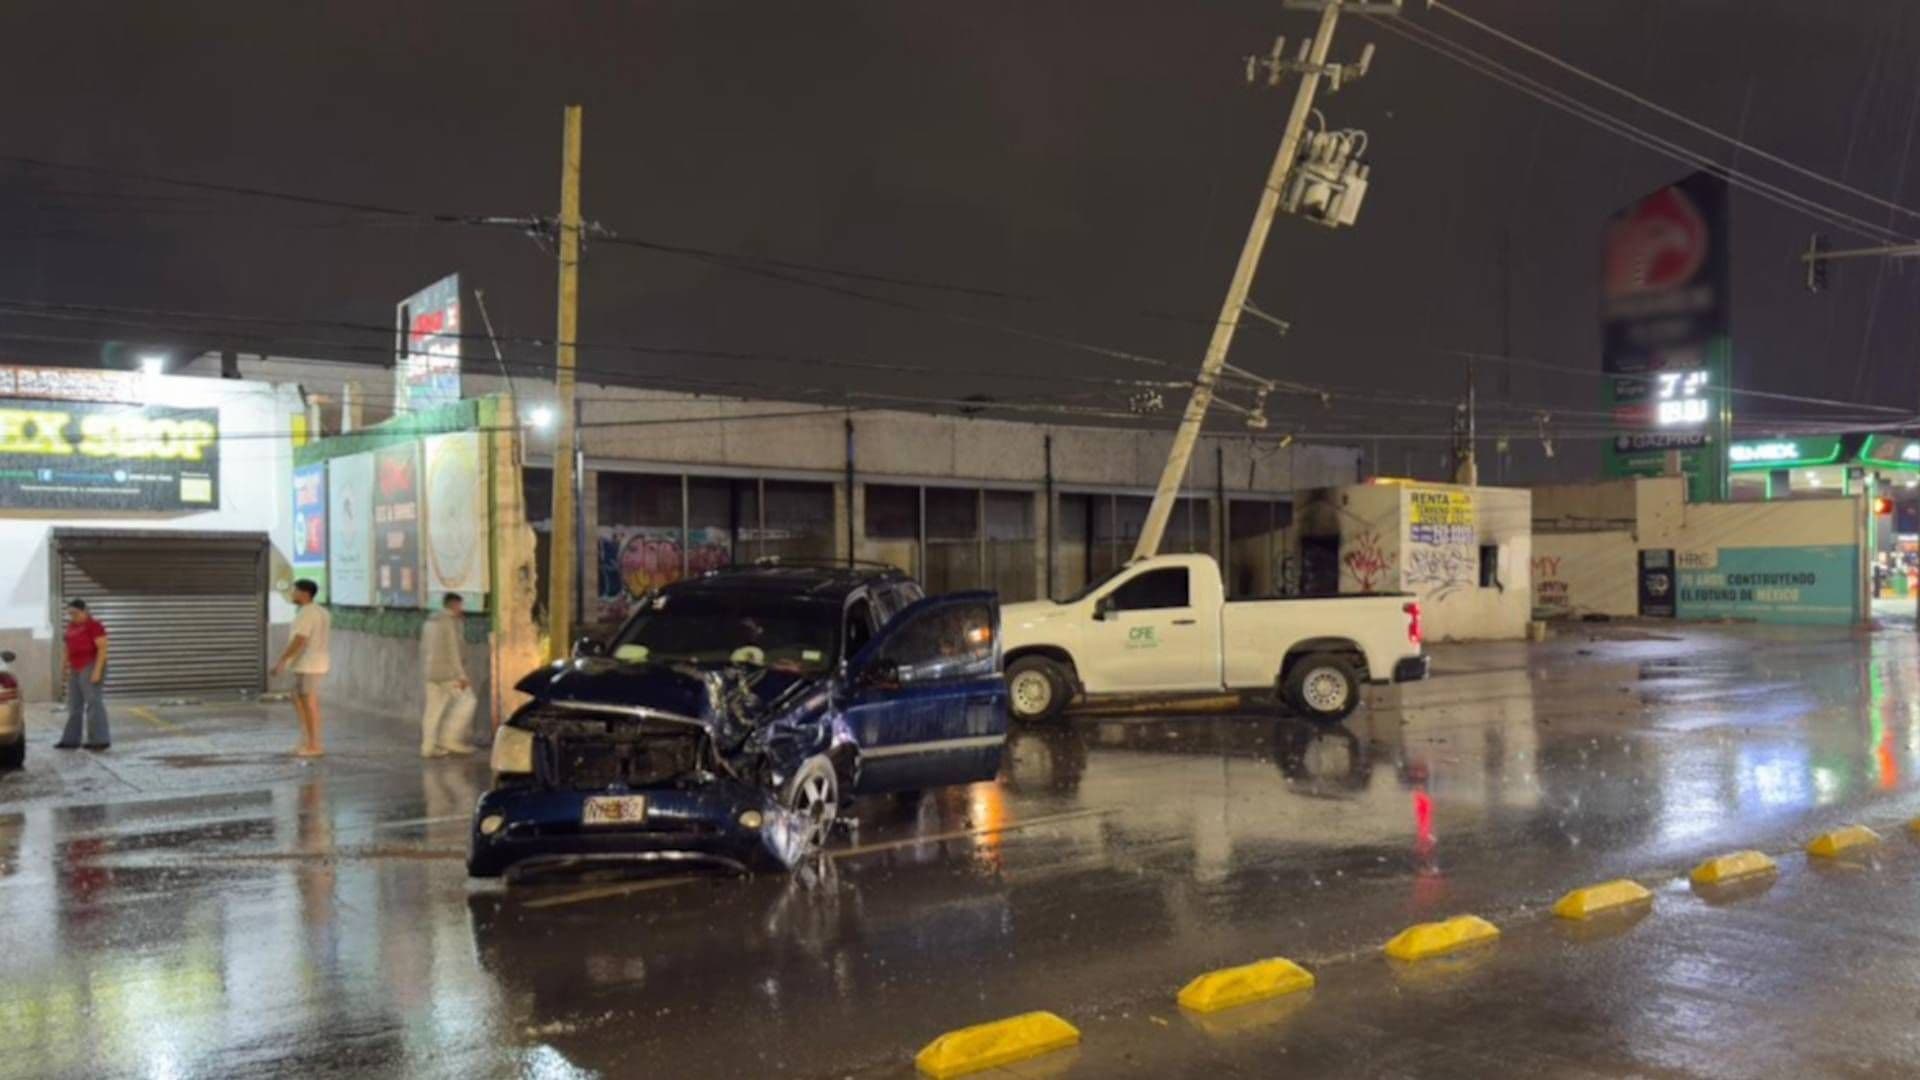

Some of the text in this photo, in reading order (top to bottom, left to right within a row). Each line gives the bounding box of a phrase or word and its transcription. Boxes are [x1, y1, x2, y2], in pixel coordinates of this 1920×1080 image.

[1411, 493, 1449, 504] RENTA
[1727, 573, 1816, 585] CONSTRUYENDO
[1681, 590, 1694, 602] EL
[1695, 589, 1737, 601] FUTURO
[1740, 588, 1753, 601] DE
[1129, 626, 1154, 640] CFE
